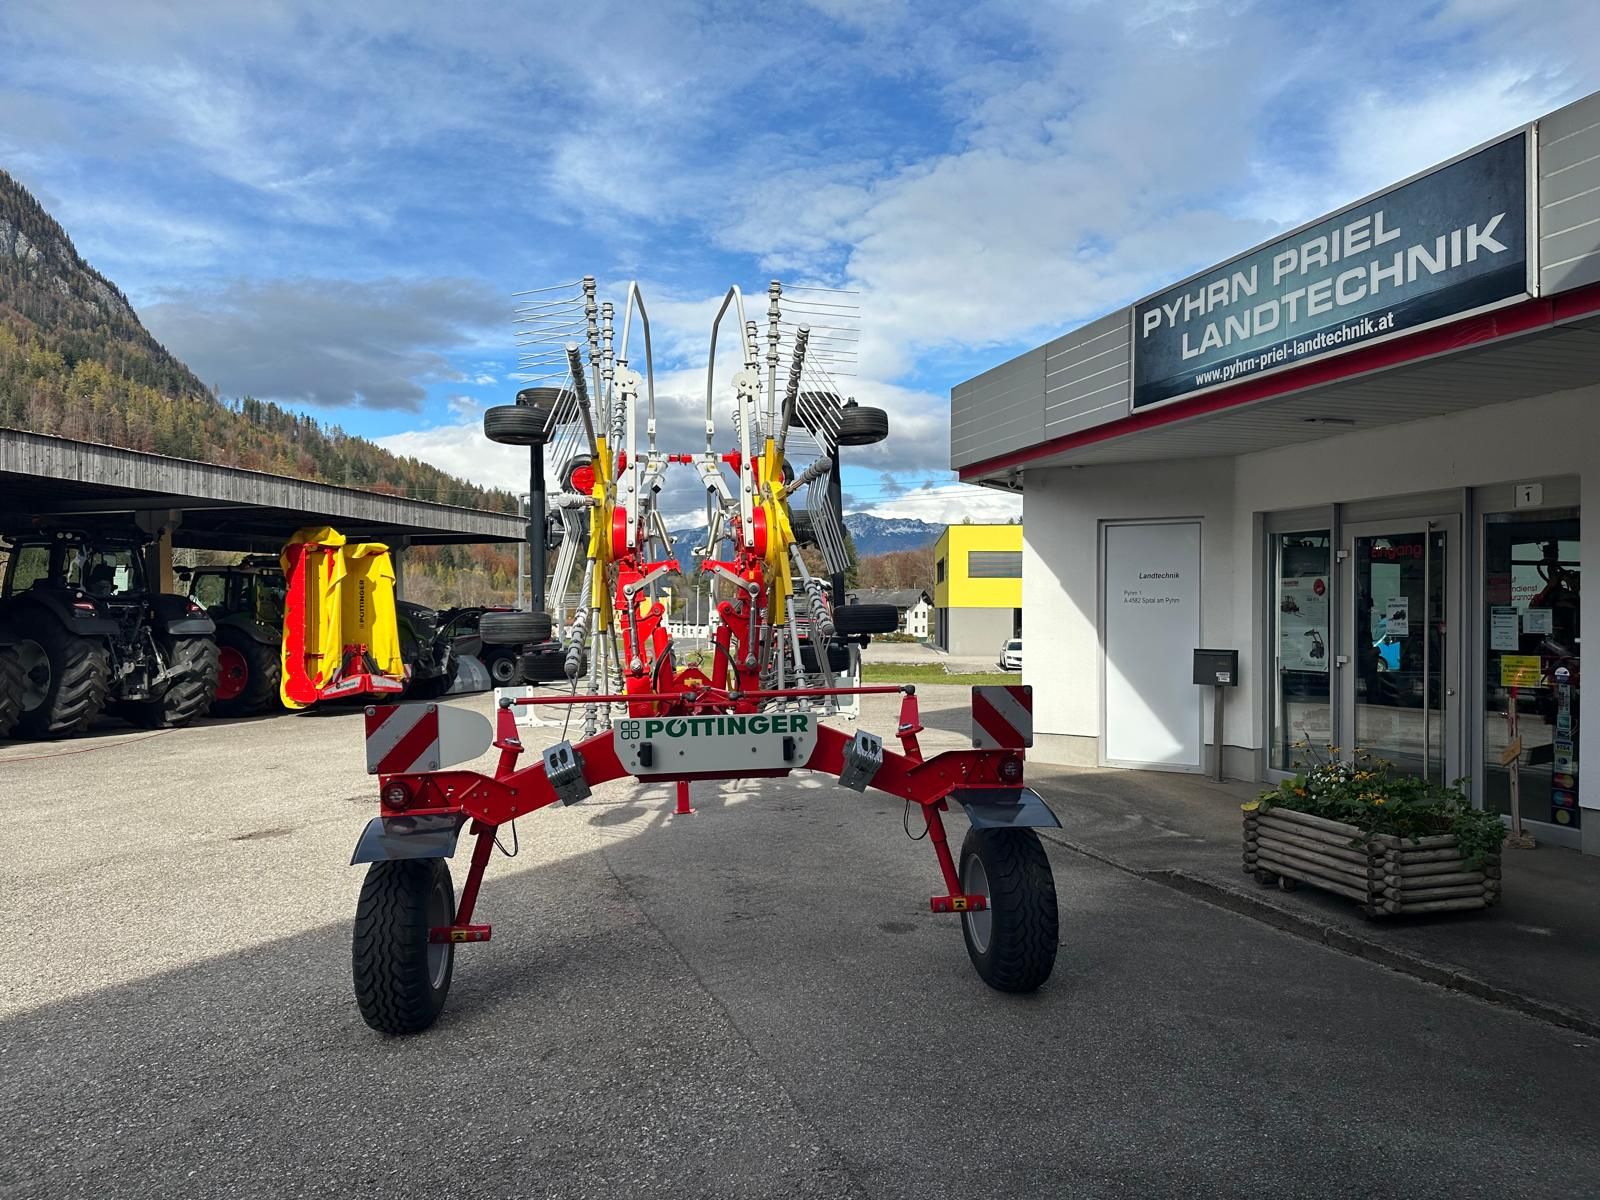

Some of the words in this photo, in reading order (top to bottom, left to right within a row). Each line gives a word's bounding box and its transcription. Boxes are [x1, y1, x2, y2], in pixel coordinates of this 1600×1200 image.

[1143, 264, 1258, 339] PYHRN
[1273, 210, 1401, 287] PRIEL
[1182, 212, 1508, 361] LANDTECHNIK
[1195, 311, 1395, 386] www.pyhrn-priel-landtechnik.at
[1525, 491, 1530, 502] 1
[1138, 572, 1180, 580] Landtechnik
[645, 714, 808, 739] PÖTTINGER
